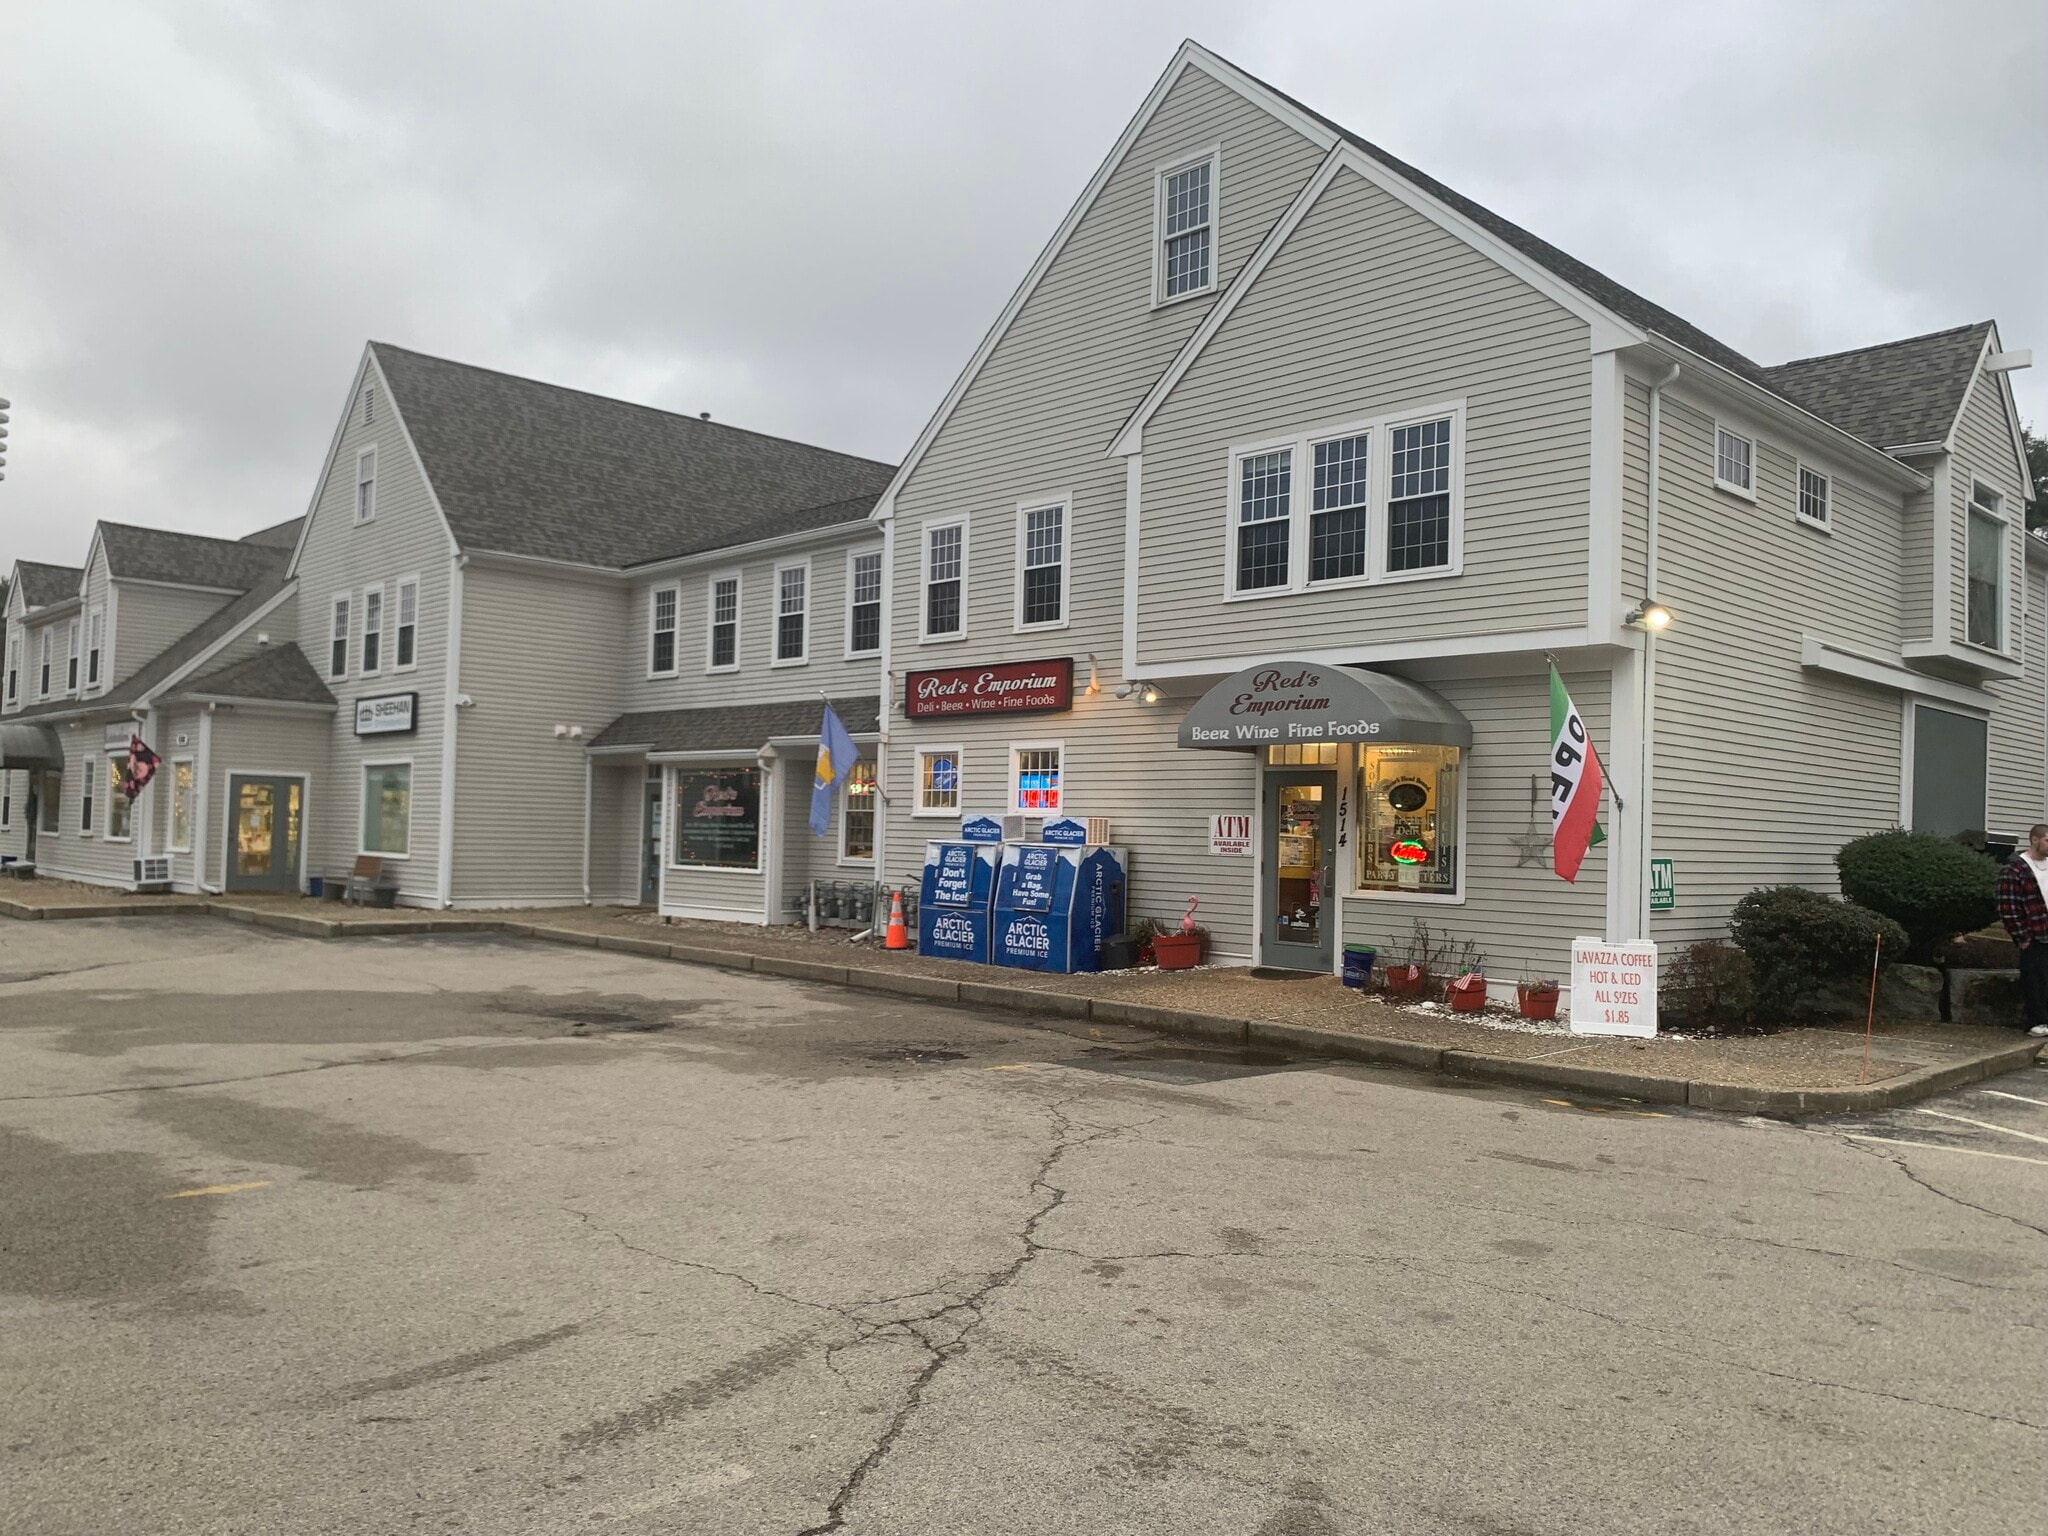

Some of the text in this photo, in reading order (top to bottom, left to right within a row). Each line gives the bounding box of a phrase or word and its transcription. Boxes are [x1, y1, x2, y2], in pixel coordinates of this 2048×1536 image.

[917, 672, 1057, 699] Red's Emporium
[1252, 669, 1321, 693] Red's
[375, 700, 410, 717] SHEEHAN
[917, 694, 1055, 713] Deli Beer Wine Fine Foods
[1229, 693, 1330, 716] Emporium
[1192, 719, 1380, 741] Beer Wine Fine Foods
[1339, 786, 1348, 847] 1514
[1214, 816, 1250, 838] ATM
[942, 867, 965, 878] Don't
[1025, 872, 1042, 881] Grab
[938, 877, 967, 890] Forget
[935, 889, 968, 901] The Ice!
[1012, 888, 1050, 898] Have Some
[1022, 897, 1037, 906] Fun!
[1094, 863, 1103, 952] ARCTIC GLACIER
[935, 917, 972, 931] ARCTIC
[1008, 922, 1048, 937] ARCTIC
[932, 928, 974, 943] GLACIER
[1005, 934, 1049, 950] GLACIER
[933, 940, 974, 951] PREMIUM ICE
[1006, 947, 1048, 959] PREMIUM ICE
[1576, 950, 1653, 968] LAVAZZA COFFEE
[1589, 971, 1641, 986] HOT & ICED
[1594, 990, 1611, 1003] ALL
[1604, 1009, 1630, 1024] $1.85
